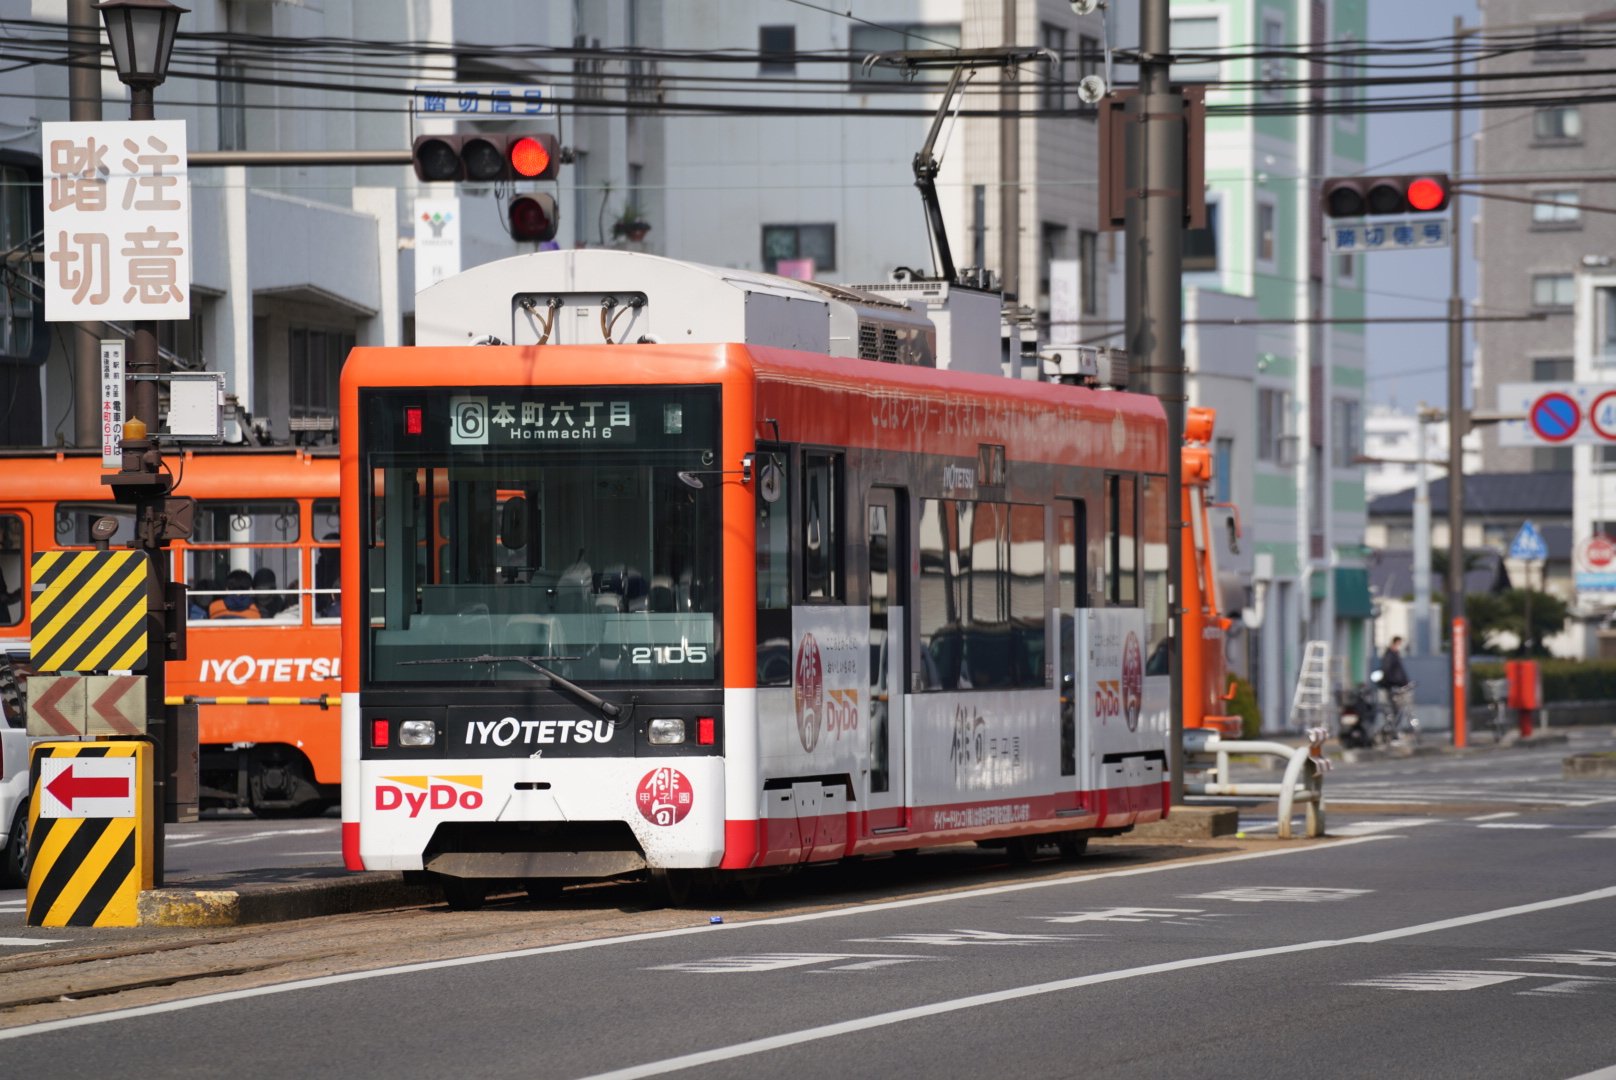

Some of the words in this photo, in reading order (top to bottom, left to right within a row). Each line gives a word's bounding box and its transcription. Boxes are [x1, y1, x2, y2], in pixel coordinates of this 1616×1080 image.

[424, 90, 541, 113] 踏切信号
[461, 406, 480, 434] 6
[491, 401, 630, 427] 本町六丁目
[510, 427, 596, 439] Hommachi
[602, 427, 612, 439] 6
[943, 464, 974, 490] IYOTETSU
[632, 646, 707, 665] 2105
[827, 701, 858, 741] DyDo
[1095, 691, 1119, 726] DyDo
[465, 717, 615, 747] IYOTETSU
[375, 785, 483, 818] DyDo
